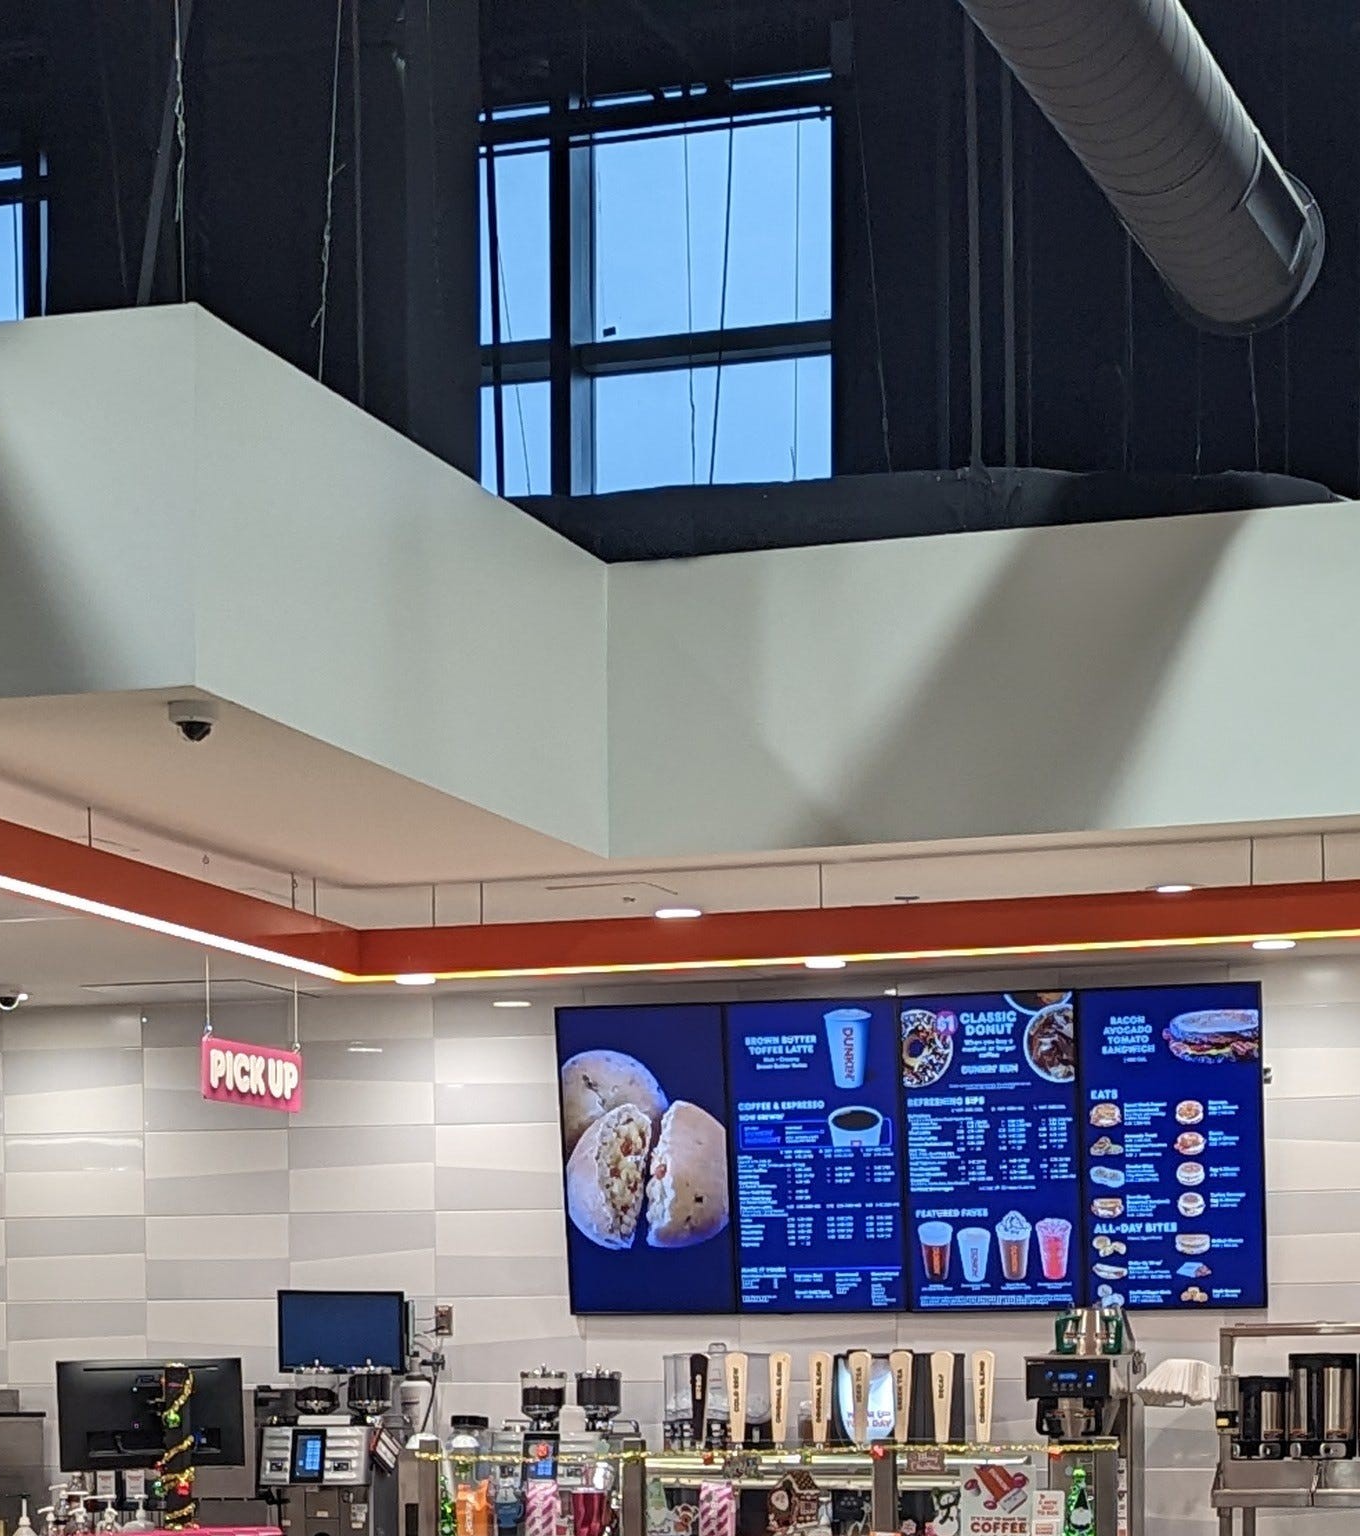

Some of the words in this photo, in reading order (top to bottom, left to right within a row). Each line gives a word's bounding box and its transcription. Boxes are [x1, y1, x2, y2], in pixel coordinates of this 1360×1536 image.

[960, 1011, 1017, 1024] CLASSIC
[965, 1024, 1014, 1036] DONUT
[1103, 1025, 1153, 1035] AVOCADO
[1107, 1035, 1149, 1045] TOMATO
[785, 1045, 814, 1054] LATTE
[210, 1048, 265, 1096] PICK
[268, 1058, 298, 1100] UP
[1090, 1089, 1118, 1100] EATS
[738, 1102, 771, 1111] COFFEE
[1094, 1223, 1142, 1234] ALL-DAY
[1145, 1222, 1178, 1233] BITES
[971, 1522, 1027, 1533] COFFEE
